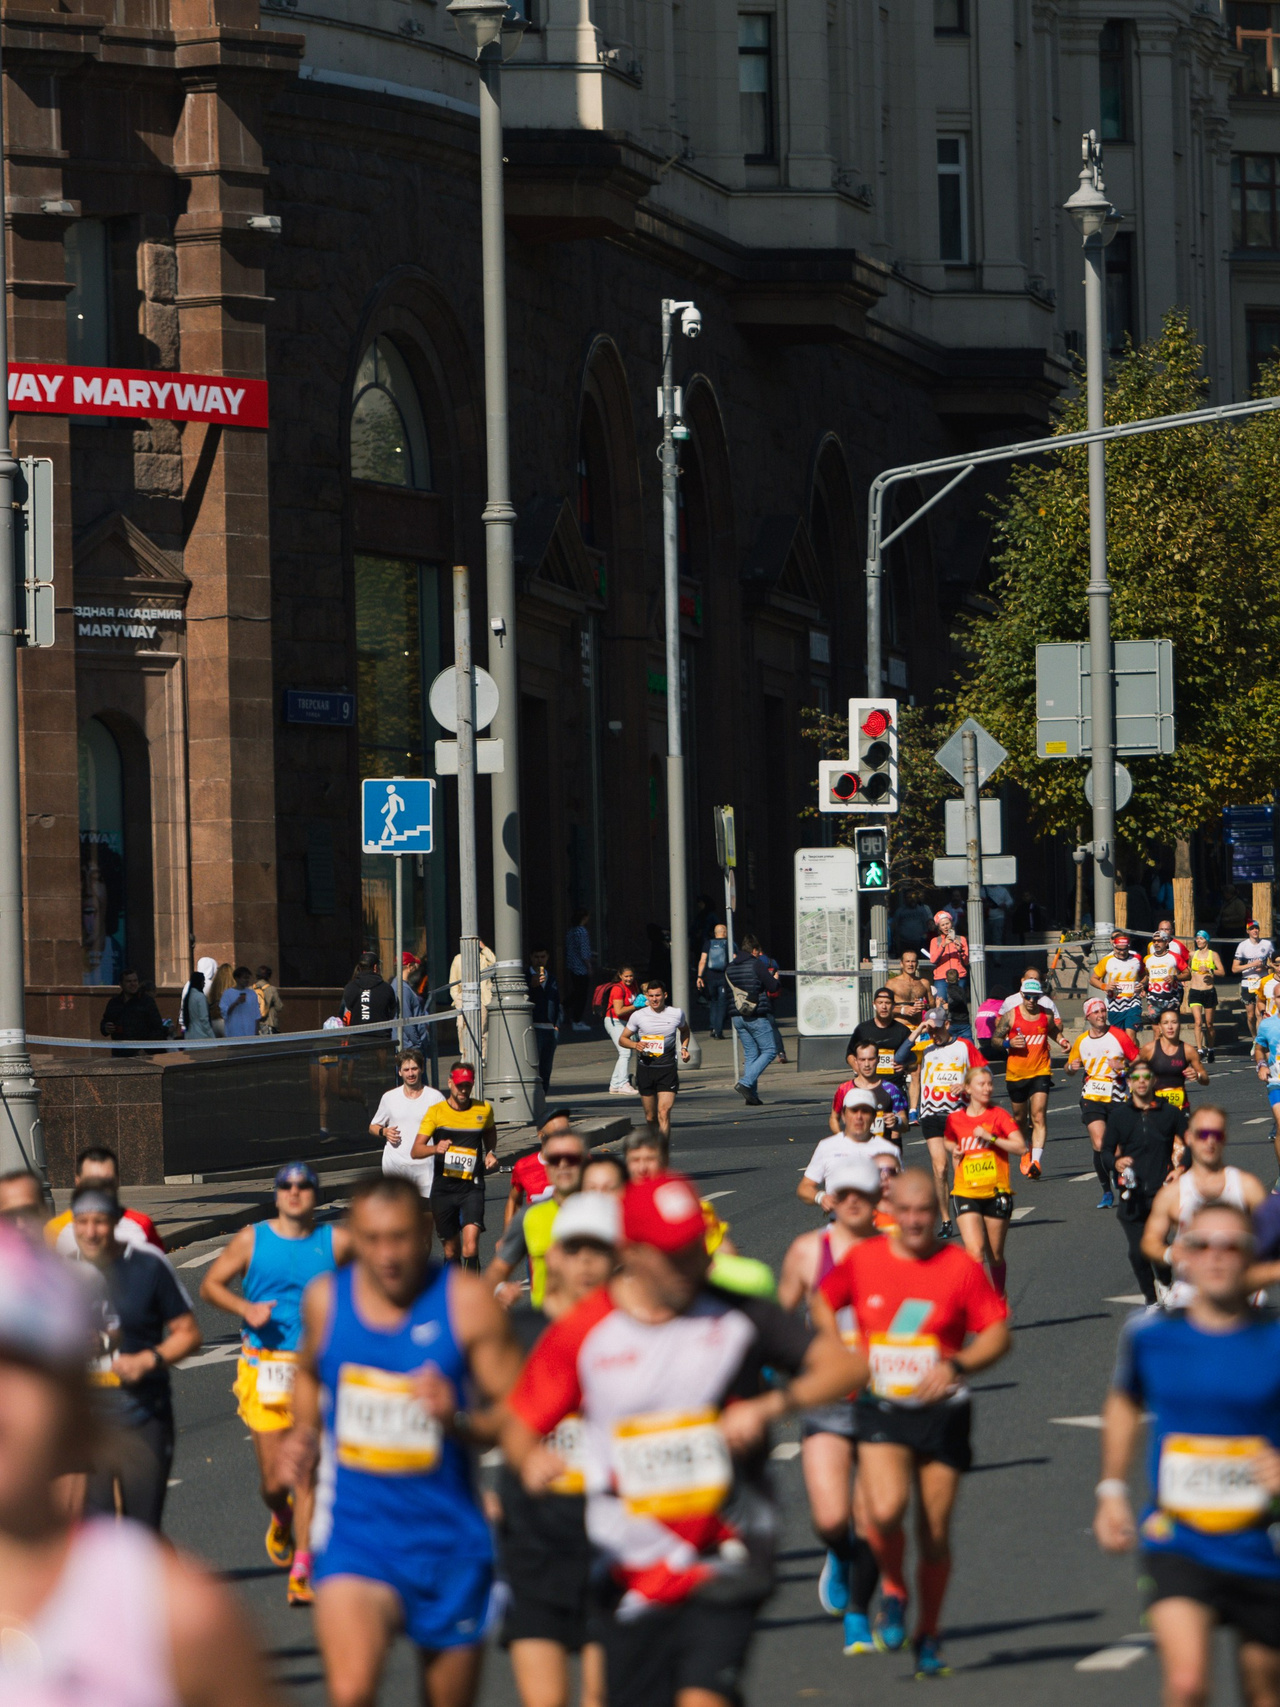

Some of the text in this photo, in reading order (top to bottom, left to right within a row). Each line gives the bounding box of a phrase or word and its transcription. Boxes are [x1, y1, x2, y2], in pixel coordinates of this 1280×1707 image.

[73, 376, 245, 415] MARYWAY
[117, 608, 182, 620] АКАДЕМИЯ
[78, 623, 157, 639] MARYWAY
[342, 702, 350, 719] 9
[361, 1004, 371, 1021] AIR
[936, 1073, 959, 1082] 4424
[1091, 1082, 1107, 1092] 544
[450, 1155, 474, 1168] 1098
[964, 1161, 995, 1175] 13044
